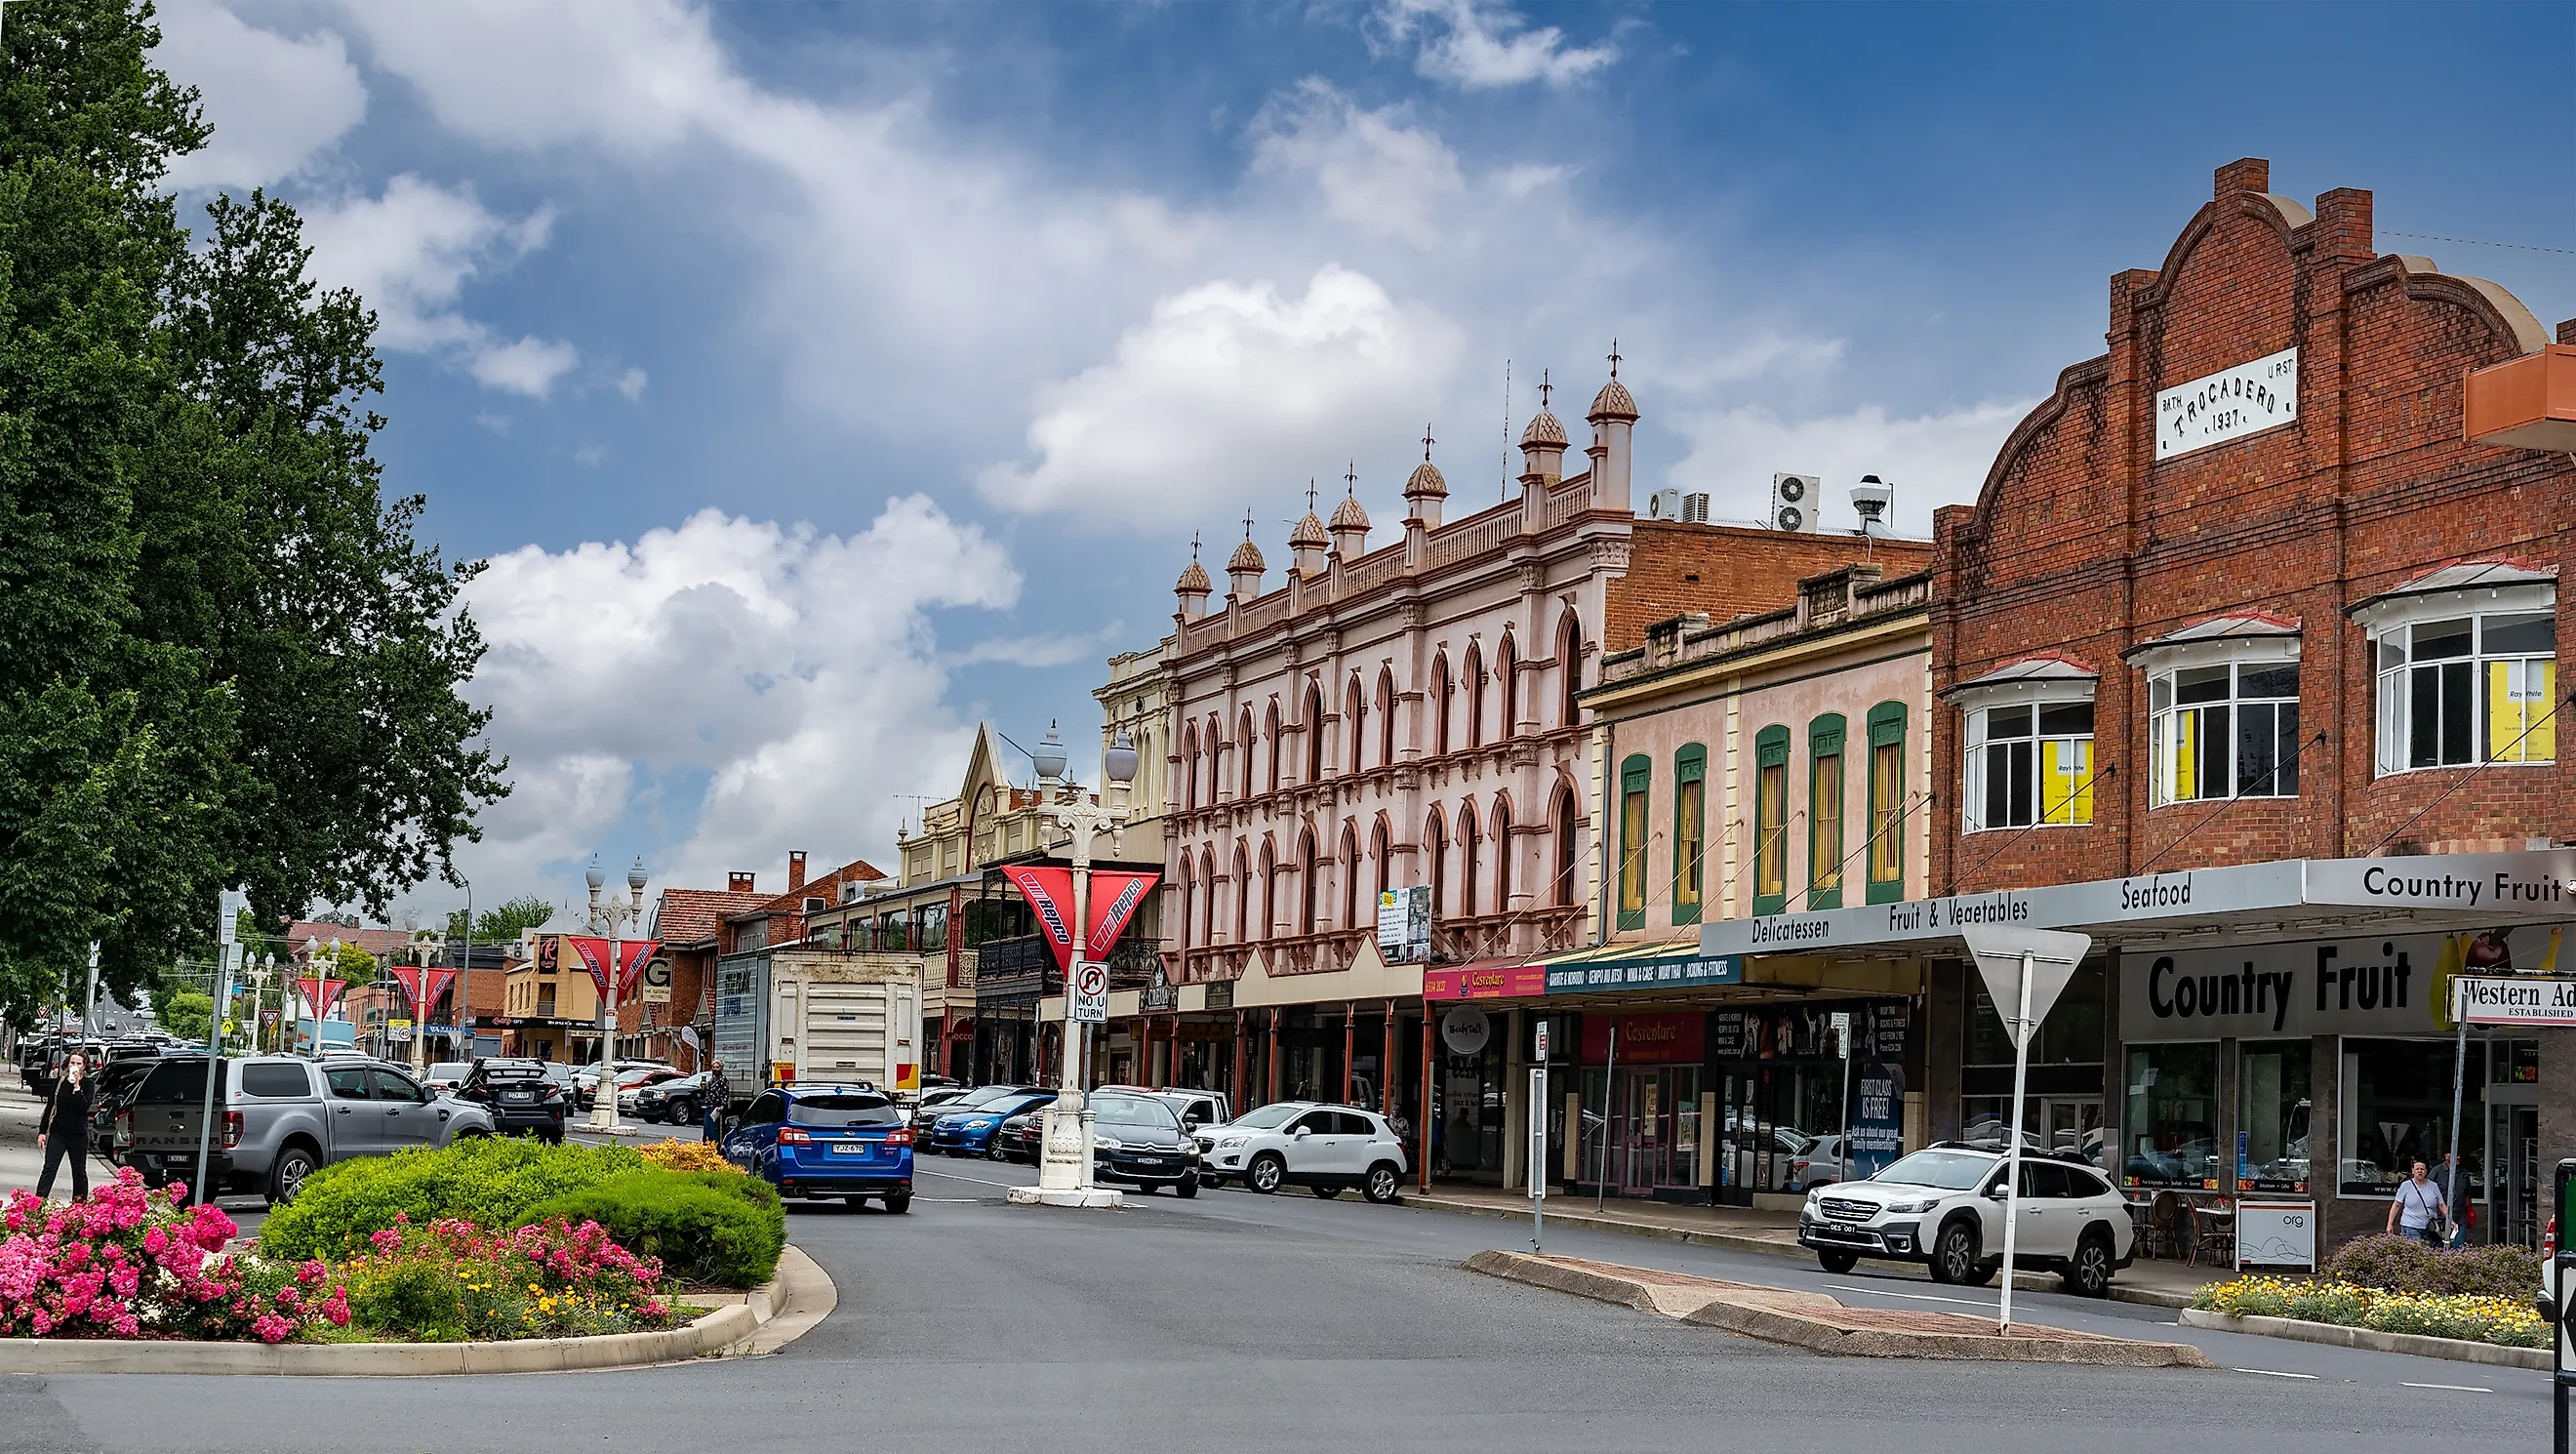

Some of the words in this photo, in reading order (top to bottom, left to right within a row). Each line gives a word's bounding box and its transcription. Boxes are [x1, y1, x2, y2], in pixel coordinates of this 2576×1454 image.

[2162, 394, 2183, 412] BATH
[2267, 358, 2293, 379] URST
[2174, 377, 2275, 437] TROCADERO
[2121, 871, 2193, 909] Seafood
[2363, 867, 2483, 907] Country
[2494, 872, 2562, 903] Fruit
[1110, 877, 1146, 924] Repco
[1038, 899, 1071, 945] Repco
[1751, 918, 1830, 944] Delicatessen
[1889, 903, 1920, 932] Fruit
[1929, 901, 1939, 928] &
[631, 945, 651, 973] Repco
[434, 973, 450, 994] Repco
[588, 959, 607, 987] Repco
[645, 959, 671, 987] G
[1550, 972, 1563, 987] KARATE
[1568, 970, 1586, 986] KOBUDO
[1686, 961, 1703, 978] BOXING
[1704, 961, 1708, 977] &
[1709, 959, 1728, 977] FITNESS
[404, 983, 418, 1004] Repco
[2149, 956, 2293, 1031] Country
[2316, 942, 2411, 1011] Fruit
[2463, 980, 2541, 1005] Western
[1078, 994, 1093, 1007] NO
[1097, 995, 1105, 1008] U
[1078, 1008, 1103, 1020] TURN
[2508, 1008, 2574, 1018] ESTABLISHED
[1448, 1023, 1483, 1035] BodyTalk
[1860, 1078, 1875, 1096] FIRST
[1875, 1078, 1893, 1097] CLASS
[1862, 1097, 1870, 1119] IS
[1871, 1097, 1890, 1120] FREE!
[1852, 1138, 1866, 1151] family
[1860, 1128, 1866, 1137] us
[1866, 1126, 1878, 1138] about
[1887, 1128, 1899, 1142] great
[2282, 1215, 2304, 1228] org
